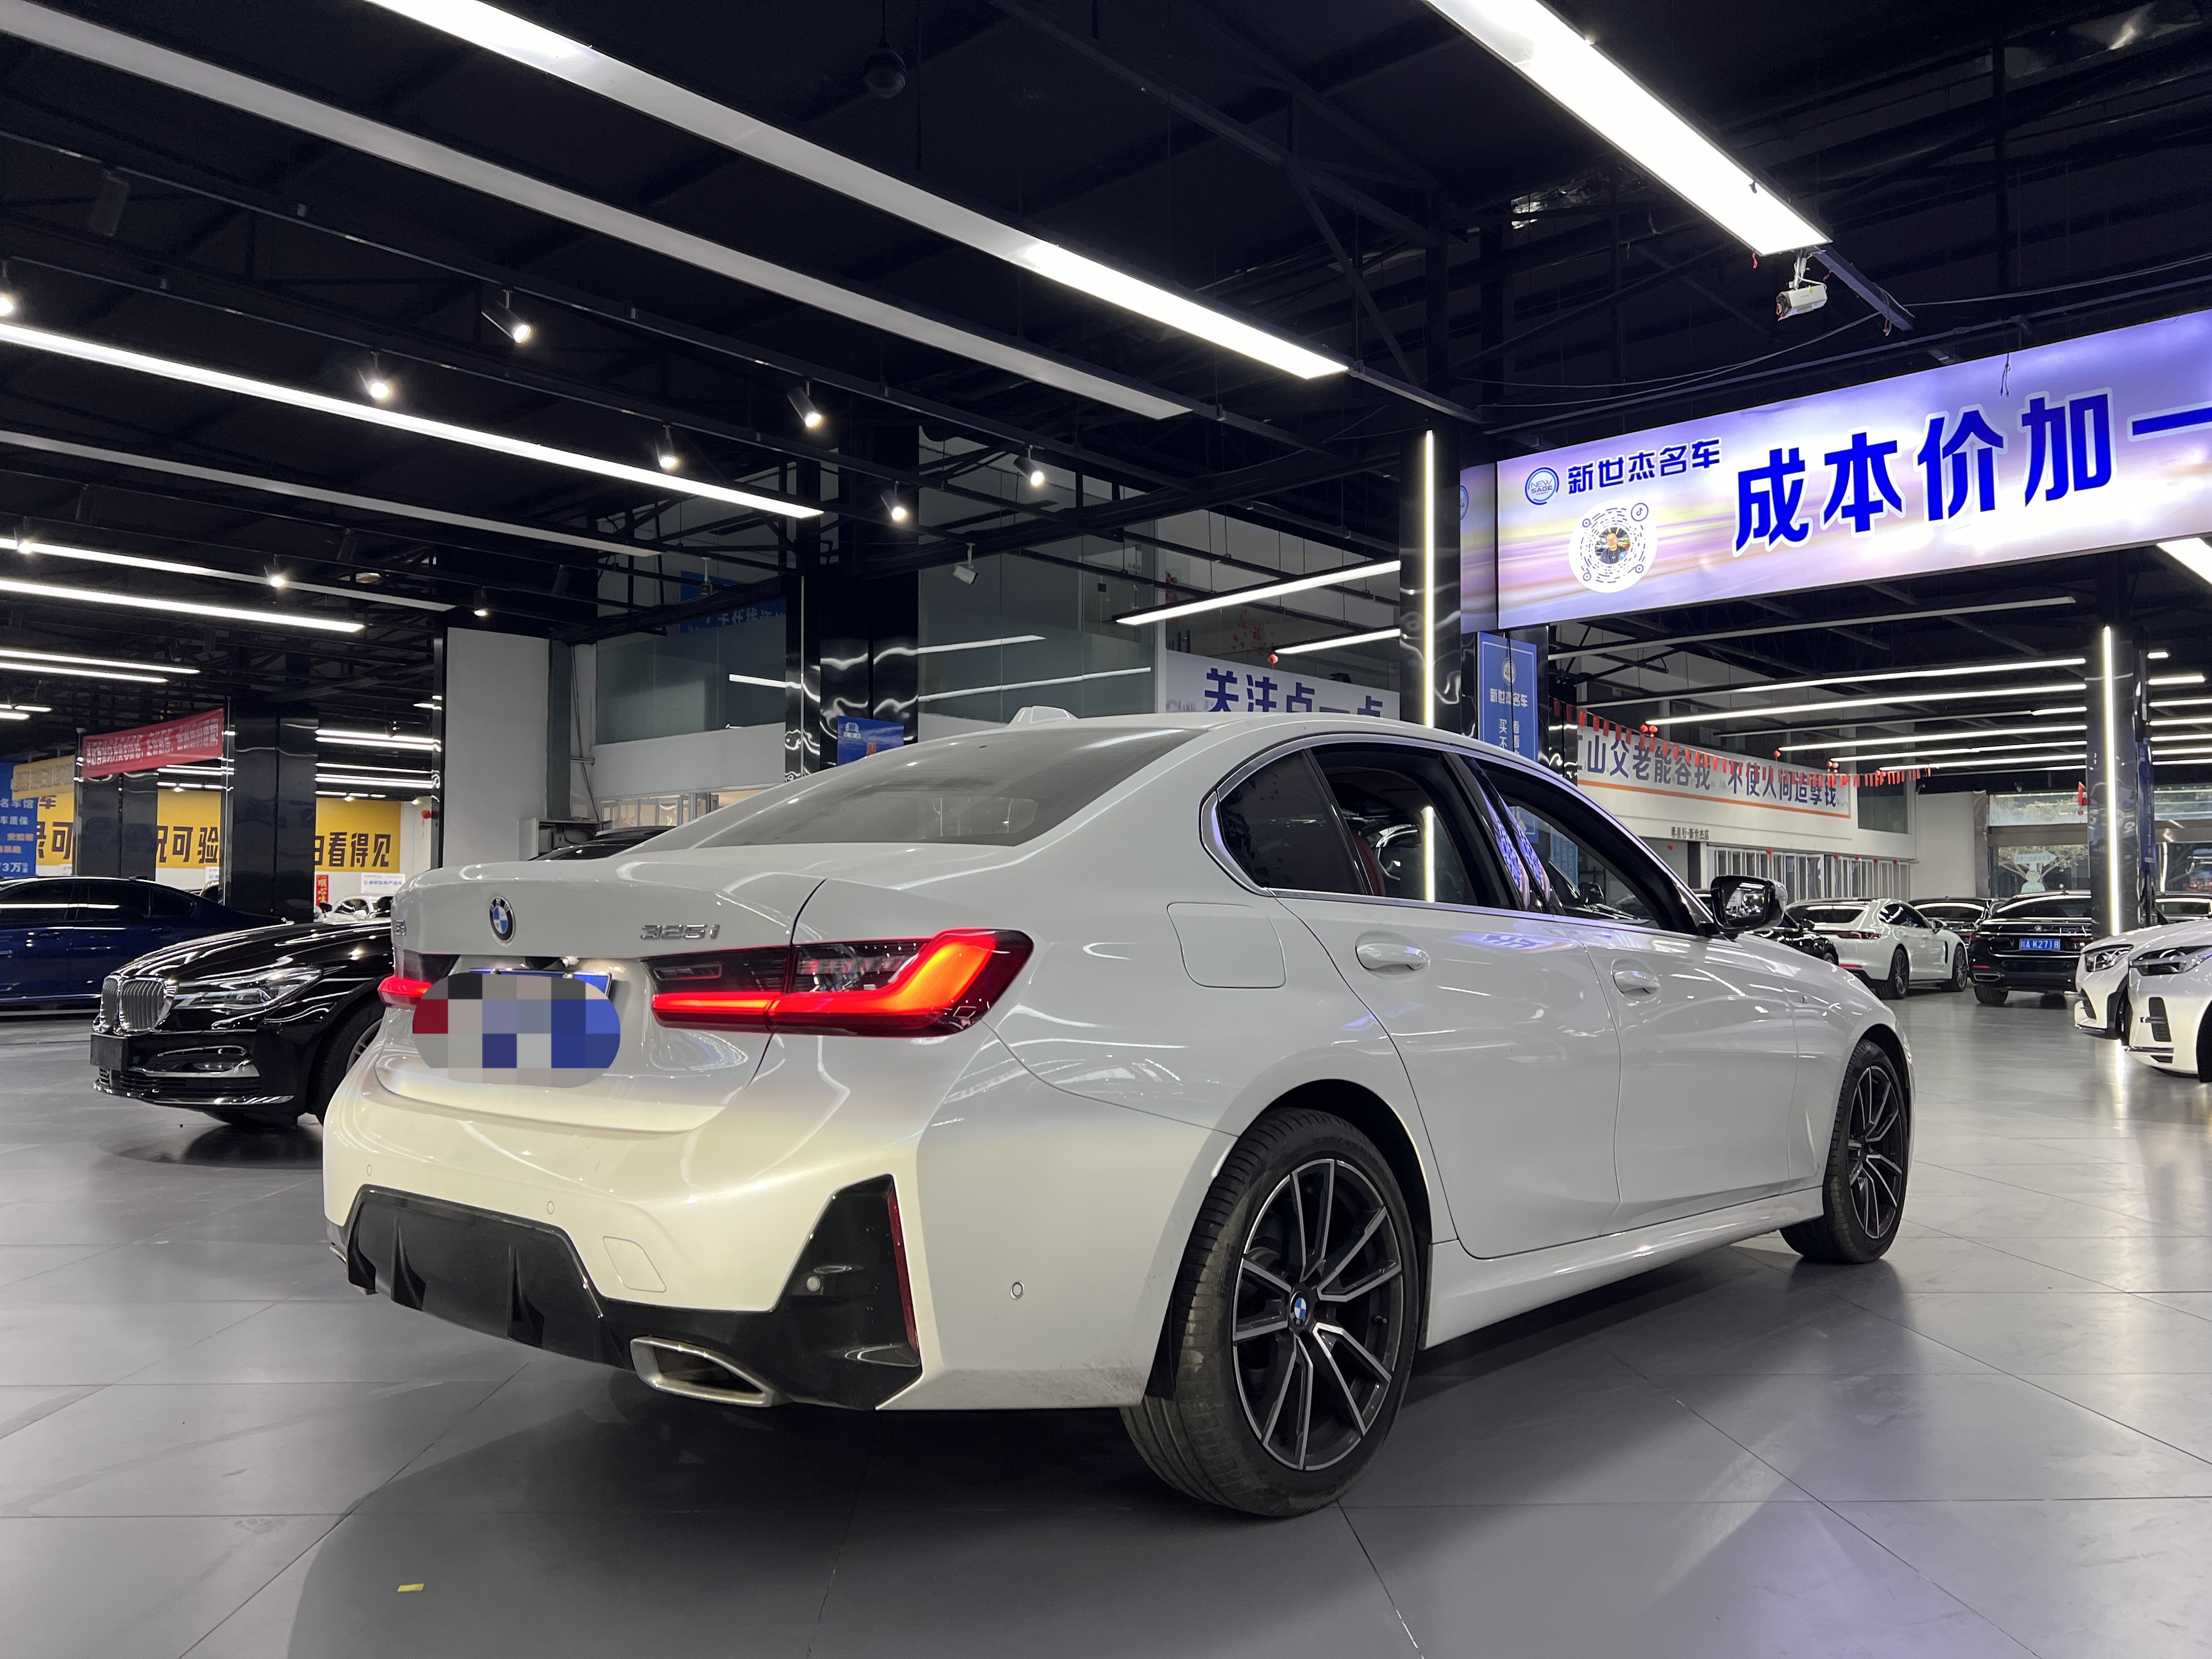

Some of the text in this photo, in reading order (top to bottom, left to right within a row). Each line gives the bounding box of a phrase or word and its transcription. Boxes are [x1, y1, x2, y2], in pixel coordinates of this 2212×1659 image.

[1531, 478, 1553, 488] NEW
[1567, 439, 1720, 494] 新世杰名车
[1735, 392, 2212, 552] 成本价加一
[1531, 484, 1553, 494] SAGE
[1577, 735, 1710, 791] 山父老能容我
[640, 924, 720, 939] 325i
